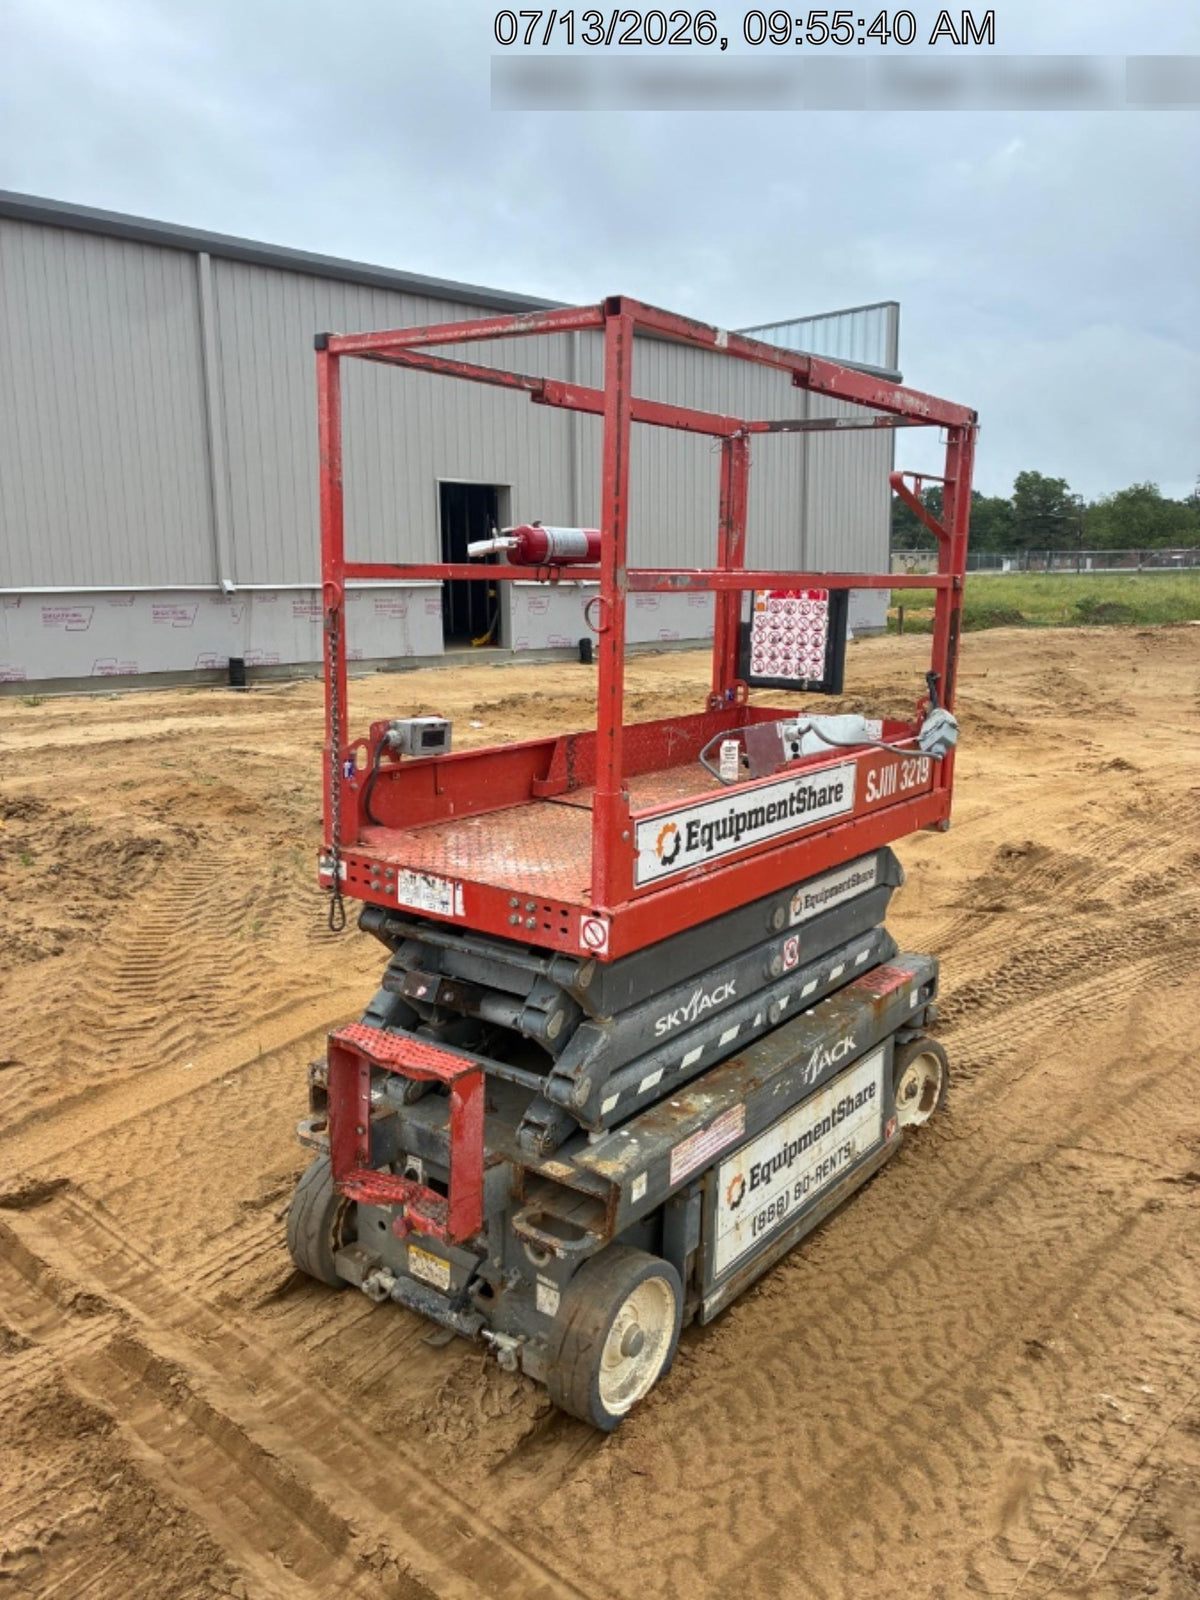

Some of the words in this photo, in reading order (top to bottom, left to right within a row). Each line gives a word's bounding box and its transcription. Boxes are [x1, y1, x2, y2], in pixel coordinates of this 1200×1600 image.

[900, 755, 930, 790] 3219
[684, 780, 844, 852] EquipmentShare
[804, 868, 875, 910] EquipmentShare
[654, 979, 737, 1038] SKYJACK
[749, 1080, 877, 1192] EquipmentShare
